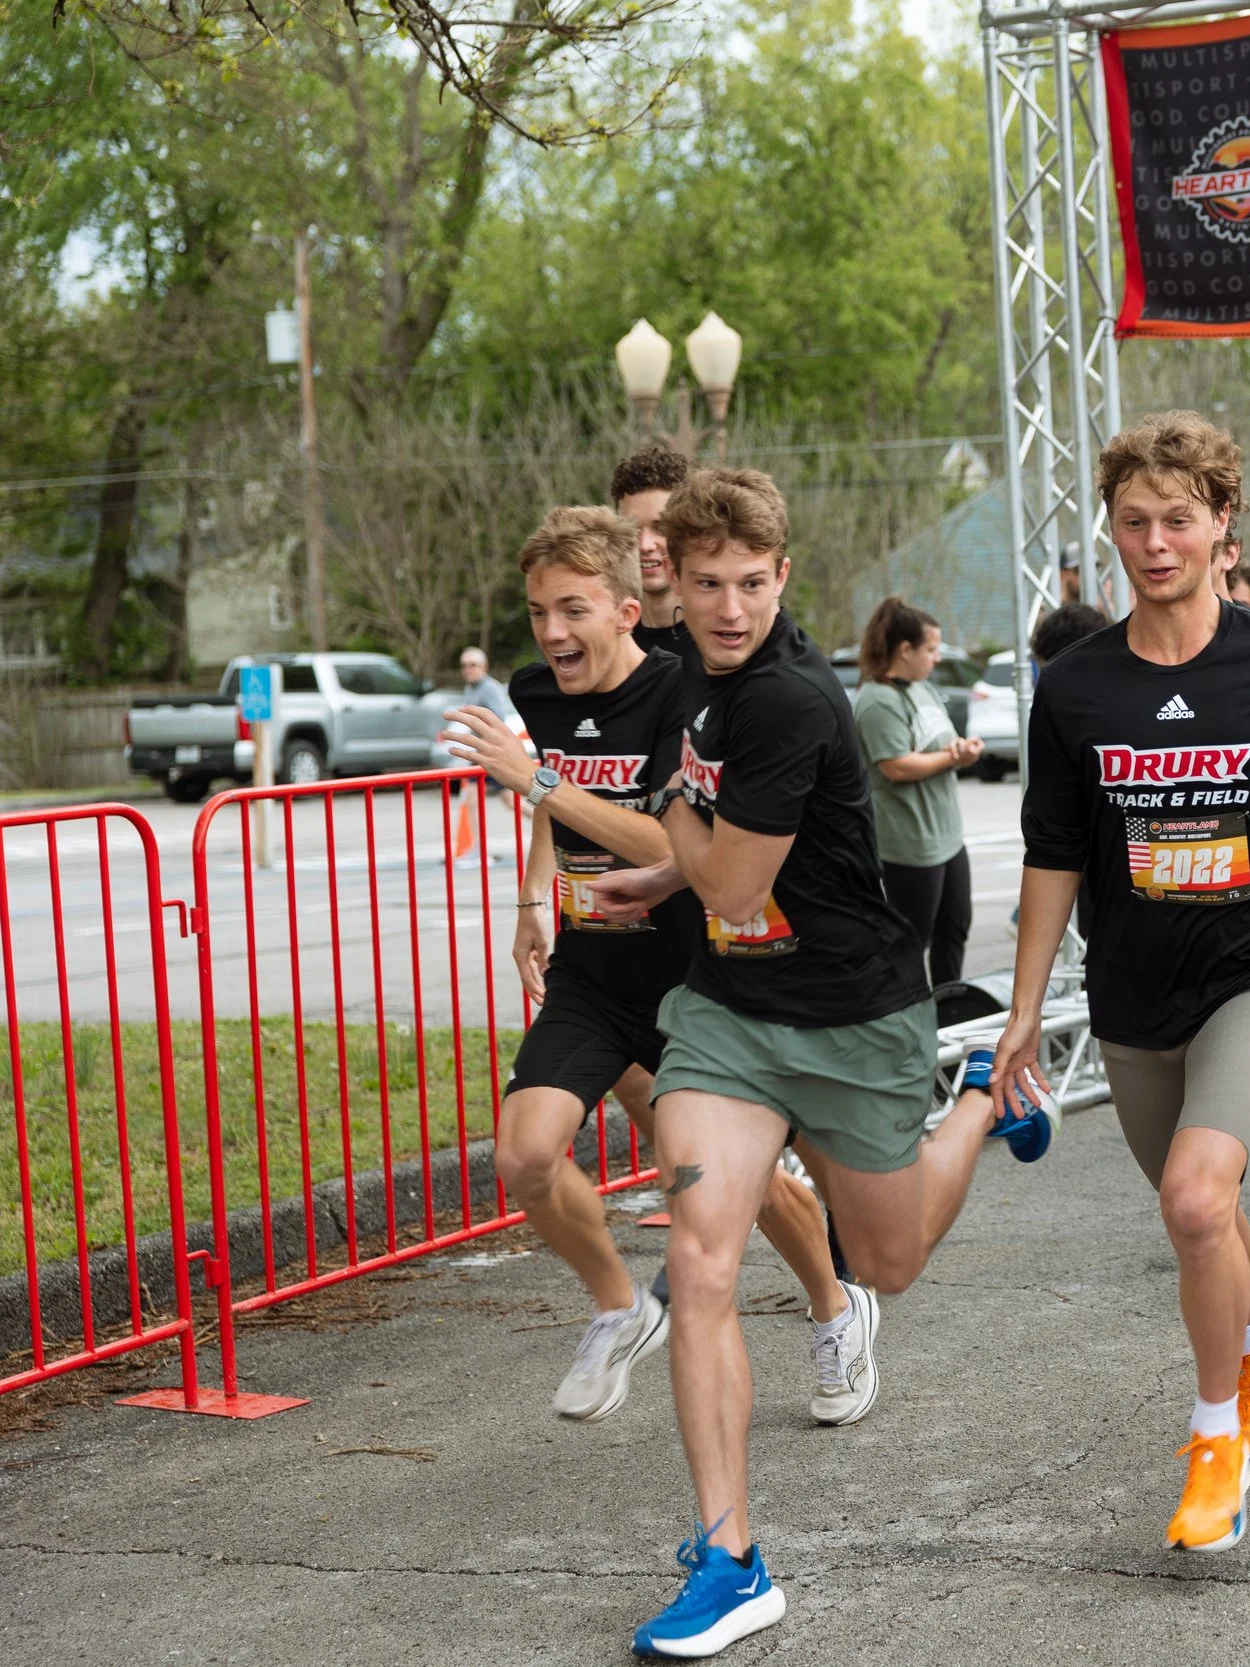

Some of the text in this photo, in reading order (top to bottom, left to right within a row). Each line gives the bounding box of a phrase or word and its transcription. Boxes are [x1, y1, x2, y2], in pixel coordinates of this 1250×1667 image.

[1156, 709, 1195, 720] adidas
[544, 750, 645, 790] DRURY
[1106, 789, 1250, 808] TRACK & FIELD
[1152, 845, 1234, 885] 2022
